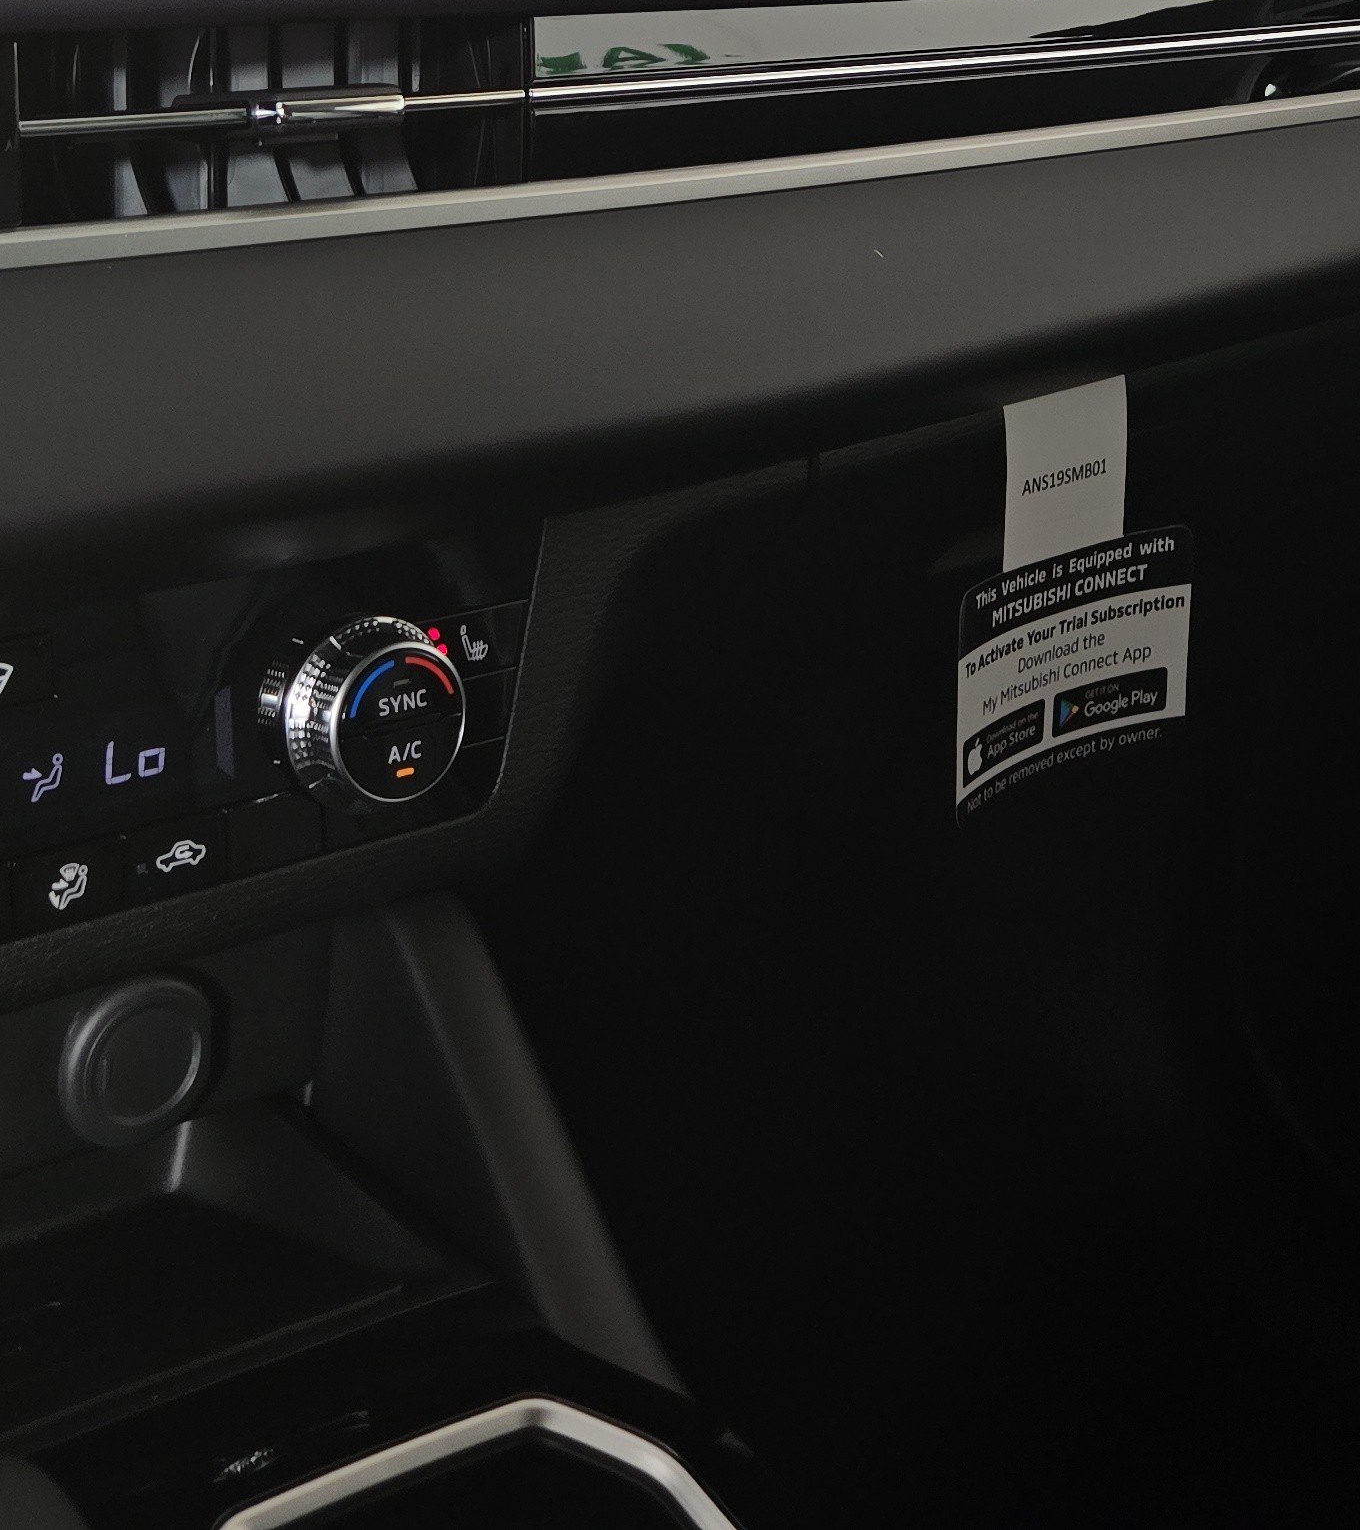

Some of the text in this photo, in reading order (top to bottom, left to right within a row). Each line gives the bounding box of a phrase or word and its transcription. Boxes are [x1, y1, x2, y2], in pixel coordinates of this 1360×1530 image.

[1020, 458, 1108, 497] ANS19SMB01
[975, 535, 1176, 611] This Vehicle is Equipped with
[990, 562, 1149, 629] MITSUBISHI CONNECT
[965, 594, 1186, 680] To Activate Your Trial Subscription
[1017, 630, 1107, 675] Download the
[378, 687, 428, 718] SYNC
[981, 645, 1153, 717] My Mitsubishi Connect App
[1082, 688, 1159, 719] Google Play
[105, 740, 166, 786] Lo
[387, 739, 423, 765] A/C
[986, 725, 1038, 761] App Store
[966, 726, 1163, 815] Not to be removed except by owner.
